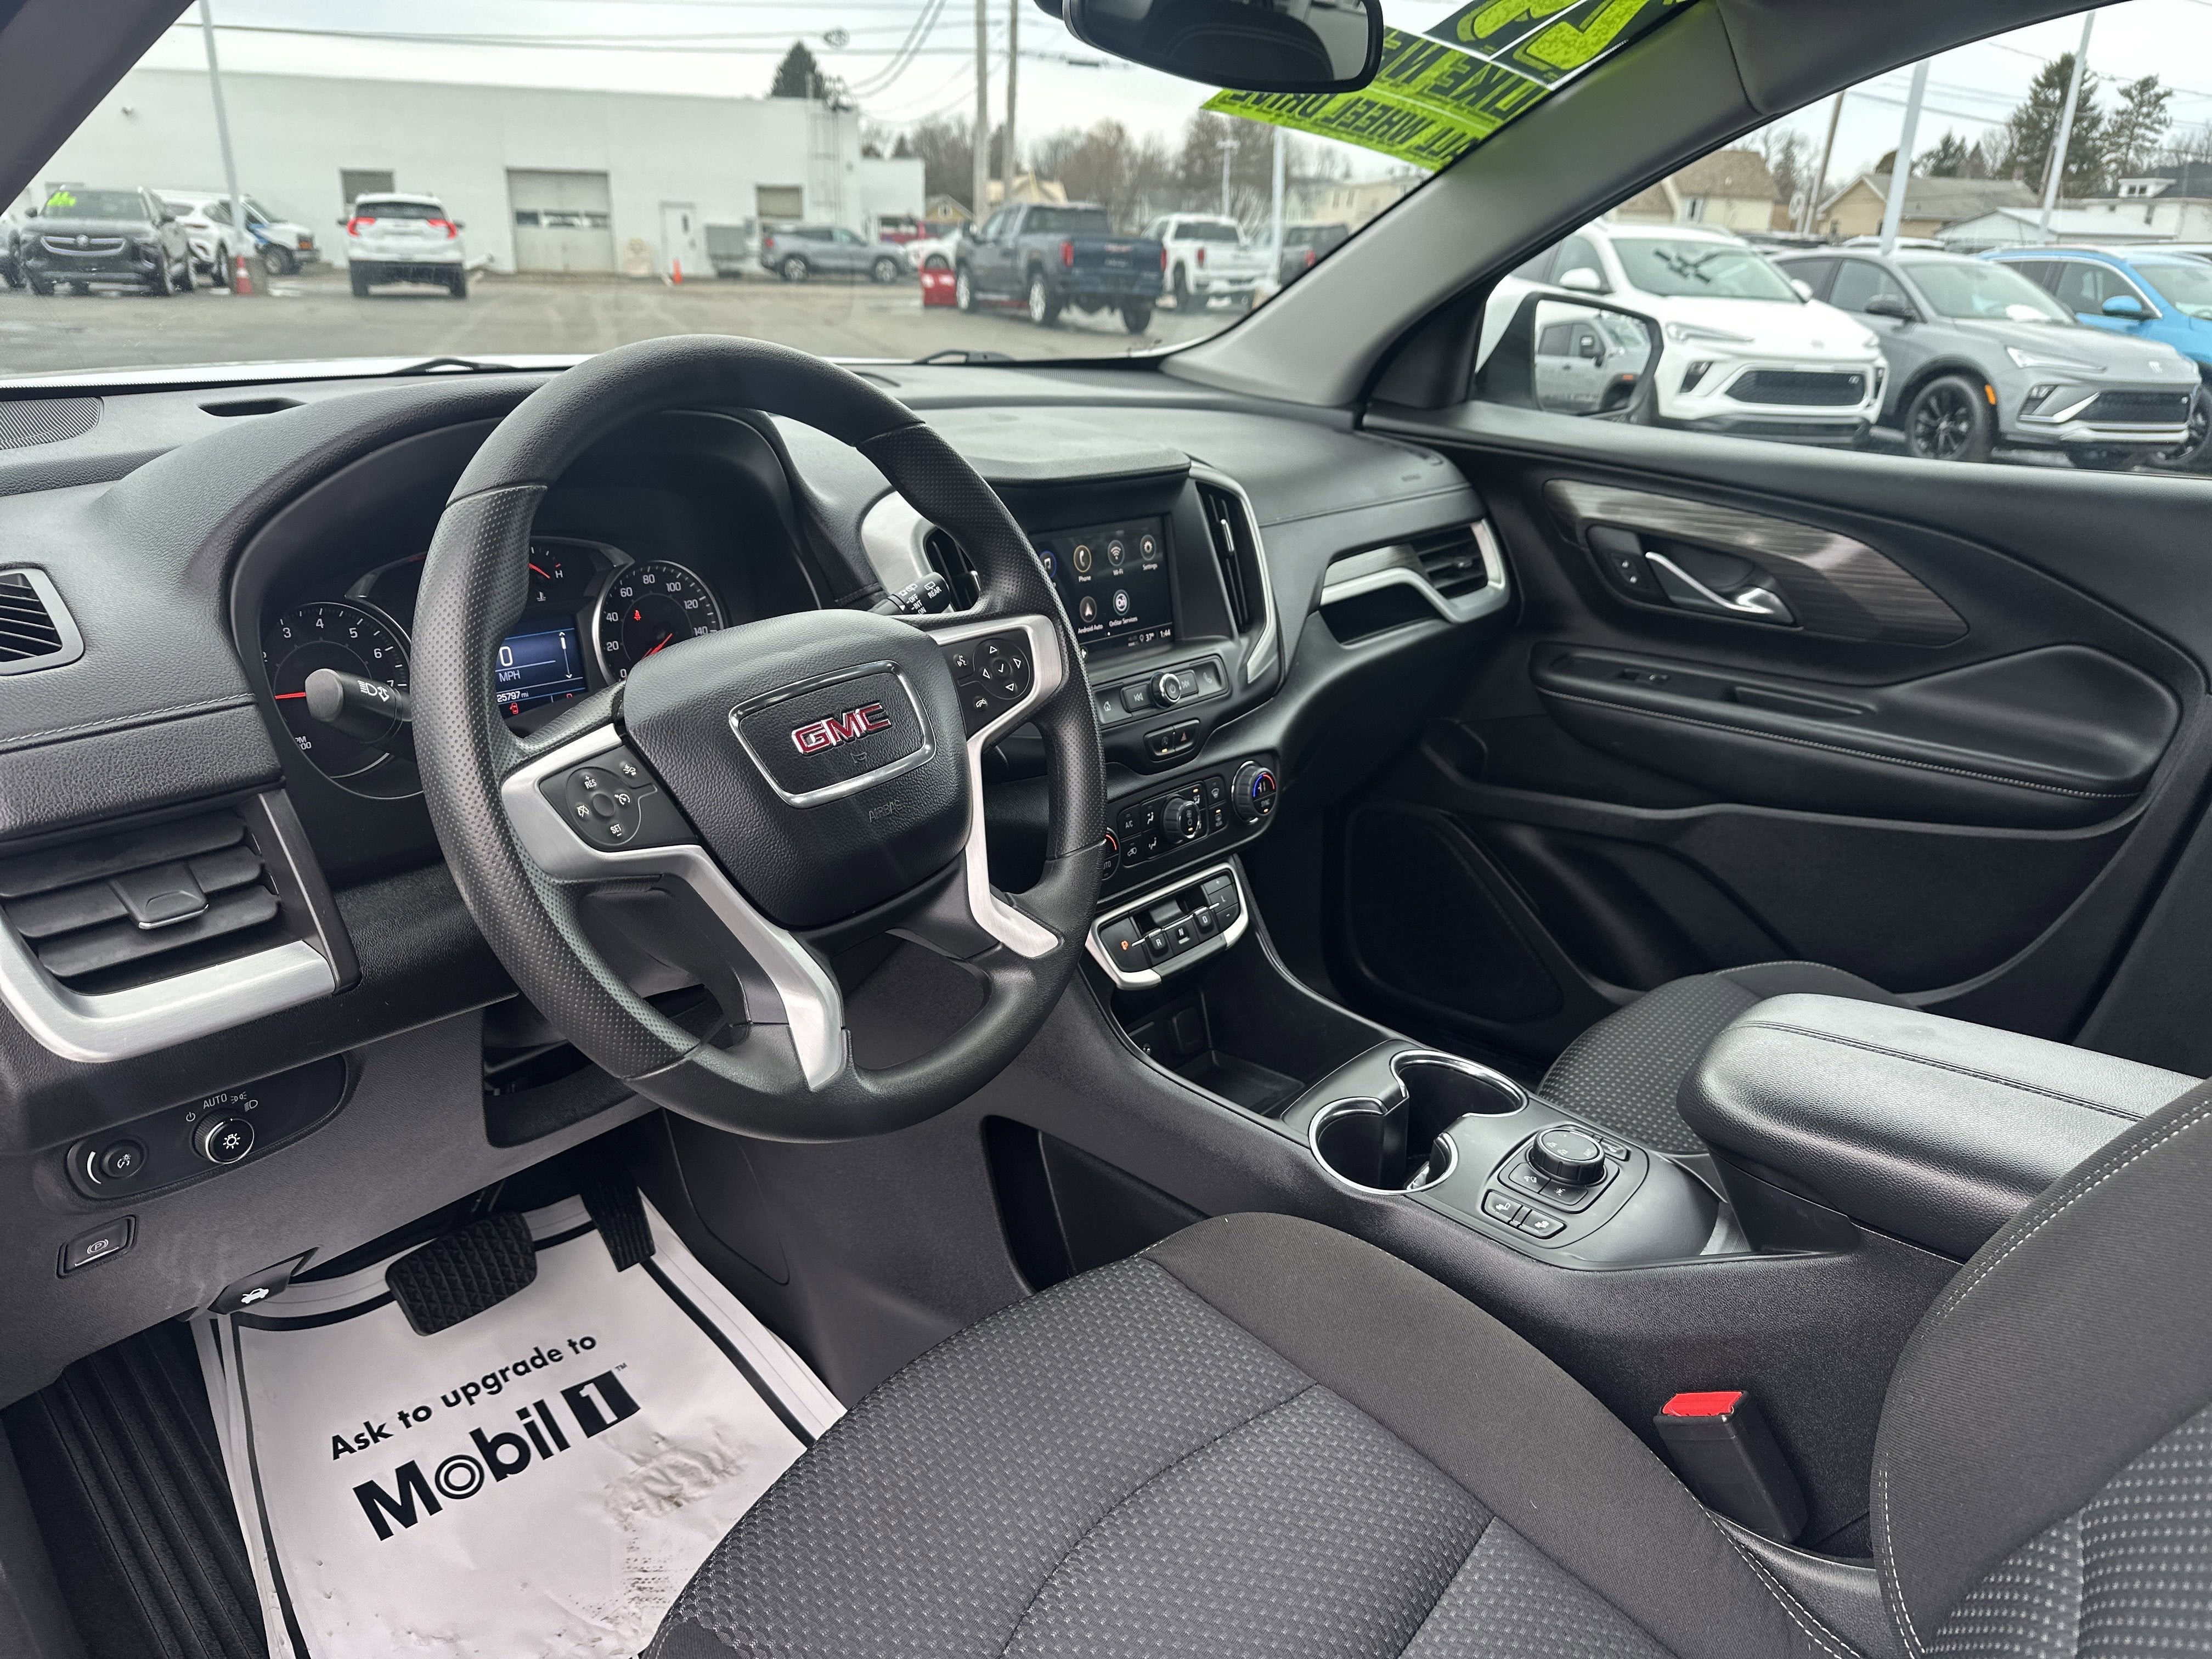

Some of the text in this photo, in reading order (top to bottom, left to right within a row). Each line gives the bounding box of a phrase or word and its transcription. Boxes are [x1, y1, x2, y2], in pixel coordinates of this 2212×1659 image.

[555, 570, 563, 578] H
[643, 574, 655, 584] 80
[620, 587, 633, 597] 60
[666, 582, 681, 592] 100
[927, 586, 942, 599] REAR
[684, 599, 698, 609] 120
[909, 594, 918, 603] OFF
[606, 612, 618, 622] 40
[1109, 616, 1138, 628] OnStar Services
[315, 618, 324, 629] 4
[1077, 624, 1093, 634] Android
[283, 627, 292, 638] 3
[349, 627, 358, 638] 5
[694, 626, 708, 636] 140
[606, 641, 619, 651] 20
[374, 648, 382, 658] 6
[499, 646, 514, 667] 0
[499, 669, 521, 682] MPH
[620, 668, 627, 678] 0
[496, 691, 521, 702] 25797
[791, 702, 892, 755] GMC
[584, 778, 597, 789] RES
[868, 799, 904, 823] AIRBAG
[610, 823, 622, 834] SET
[1121, 940, 1128, 950] P
[1155, 938, 1162, 946] R
[202, 1093, 228, 1109] AUTO
[331, 1335, 597, 1460] Ask to upgrade to
[352, 1399, 571, 1542] Mobil
